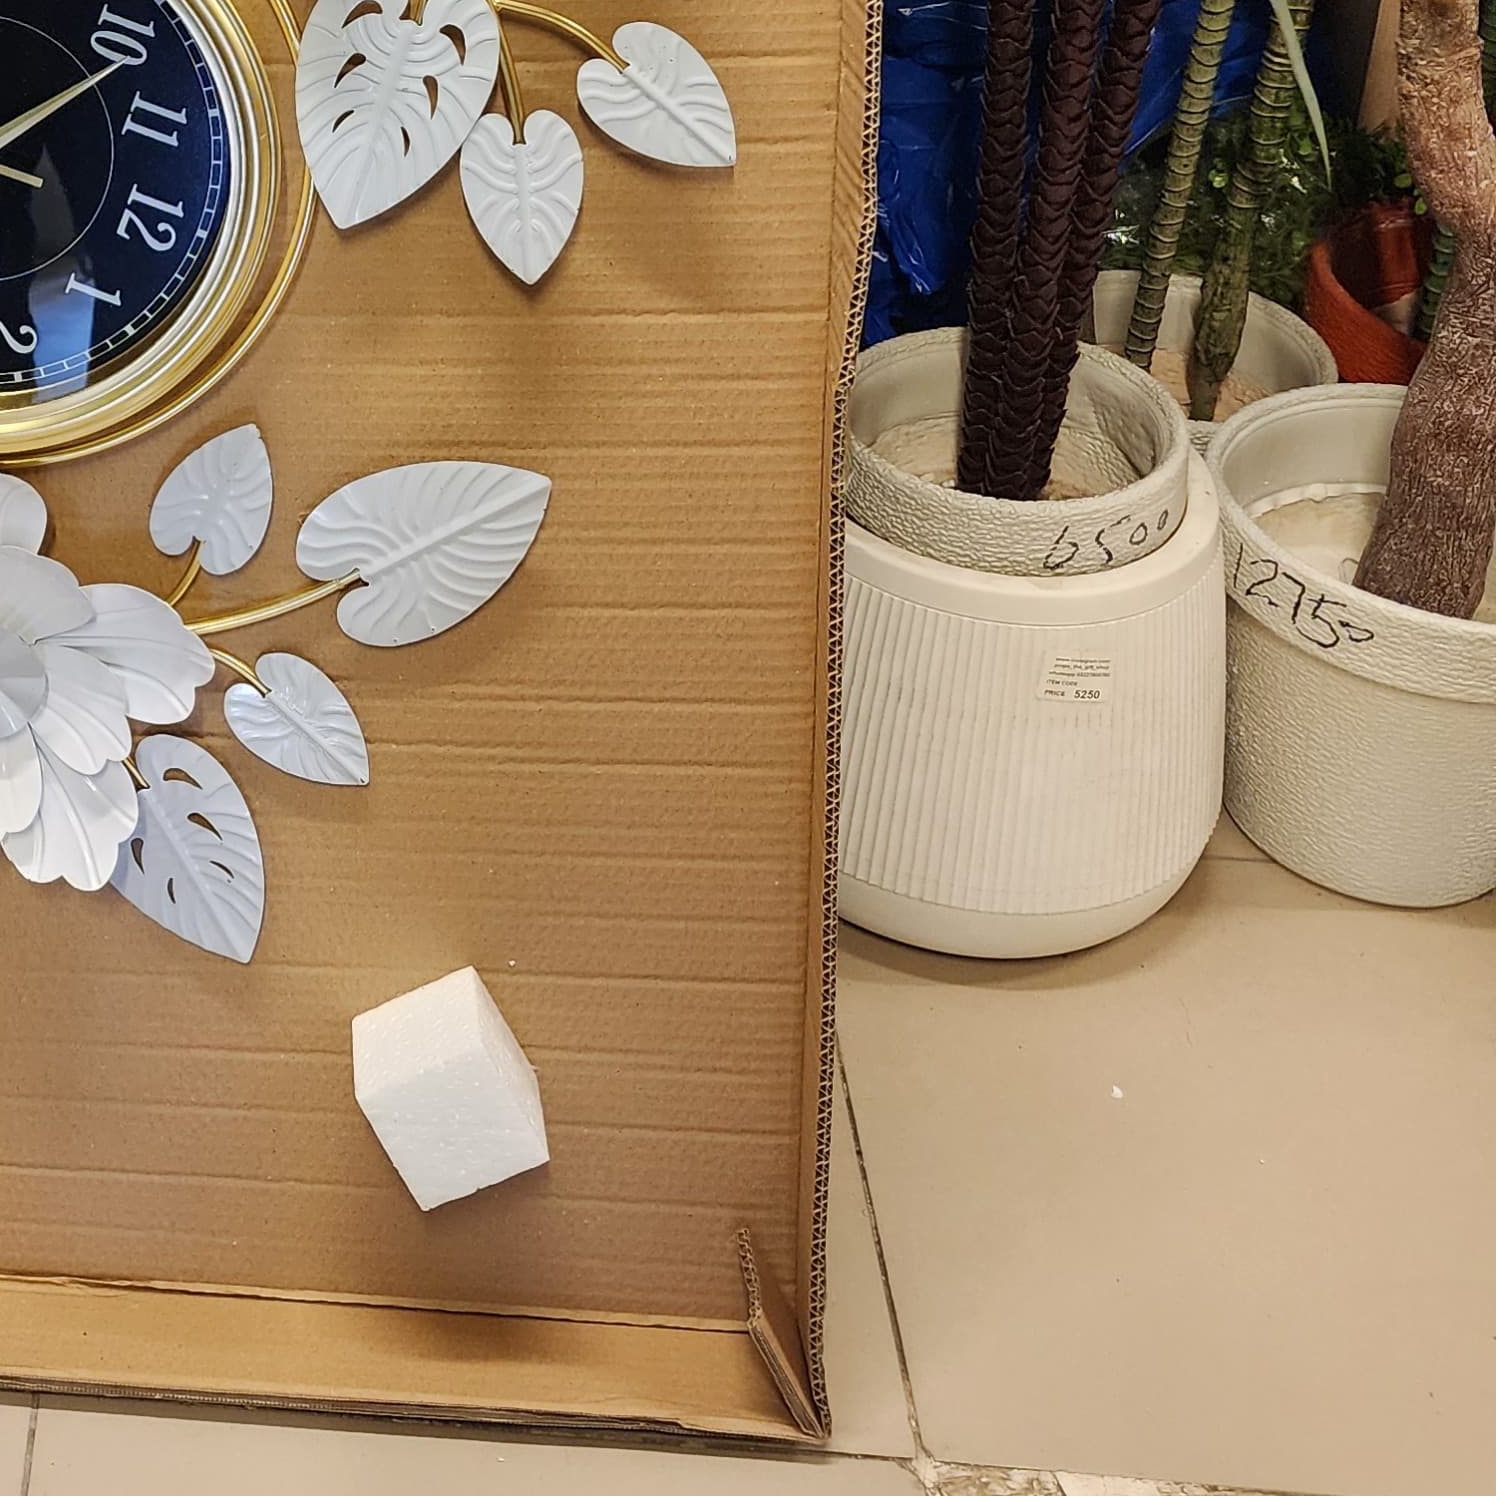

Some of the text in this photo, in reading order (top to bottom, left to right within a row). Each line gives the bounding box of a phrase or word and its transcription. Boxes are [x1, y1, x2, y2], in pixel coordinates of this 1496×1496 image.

[90, 4, 156, 66] 10
[122, 91, 188, 147] 11
[117, 184, 184, 252] 12
[65, 273, 122, 307] 1
[1232, 542, 1375, 648] 12750
[1073, 689, 1101, 699] 5250
